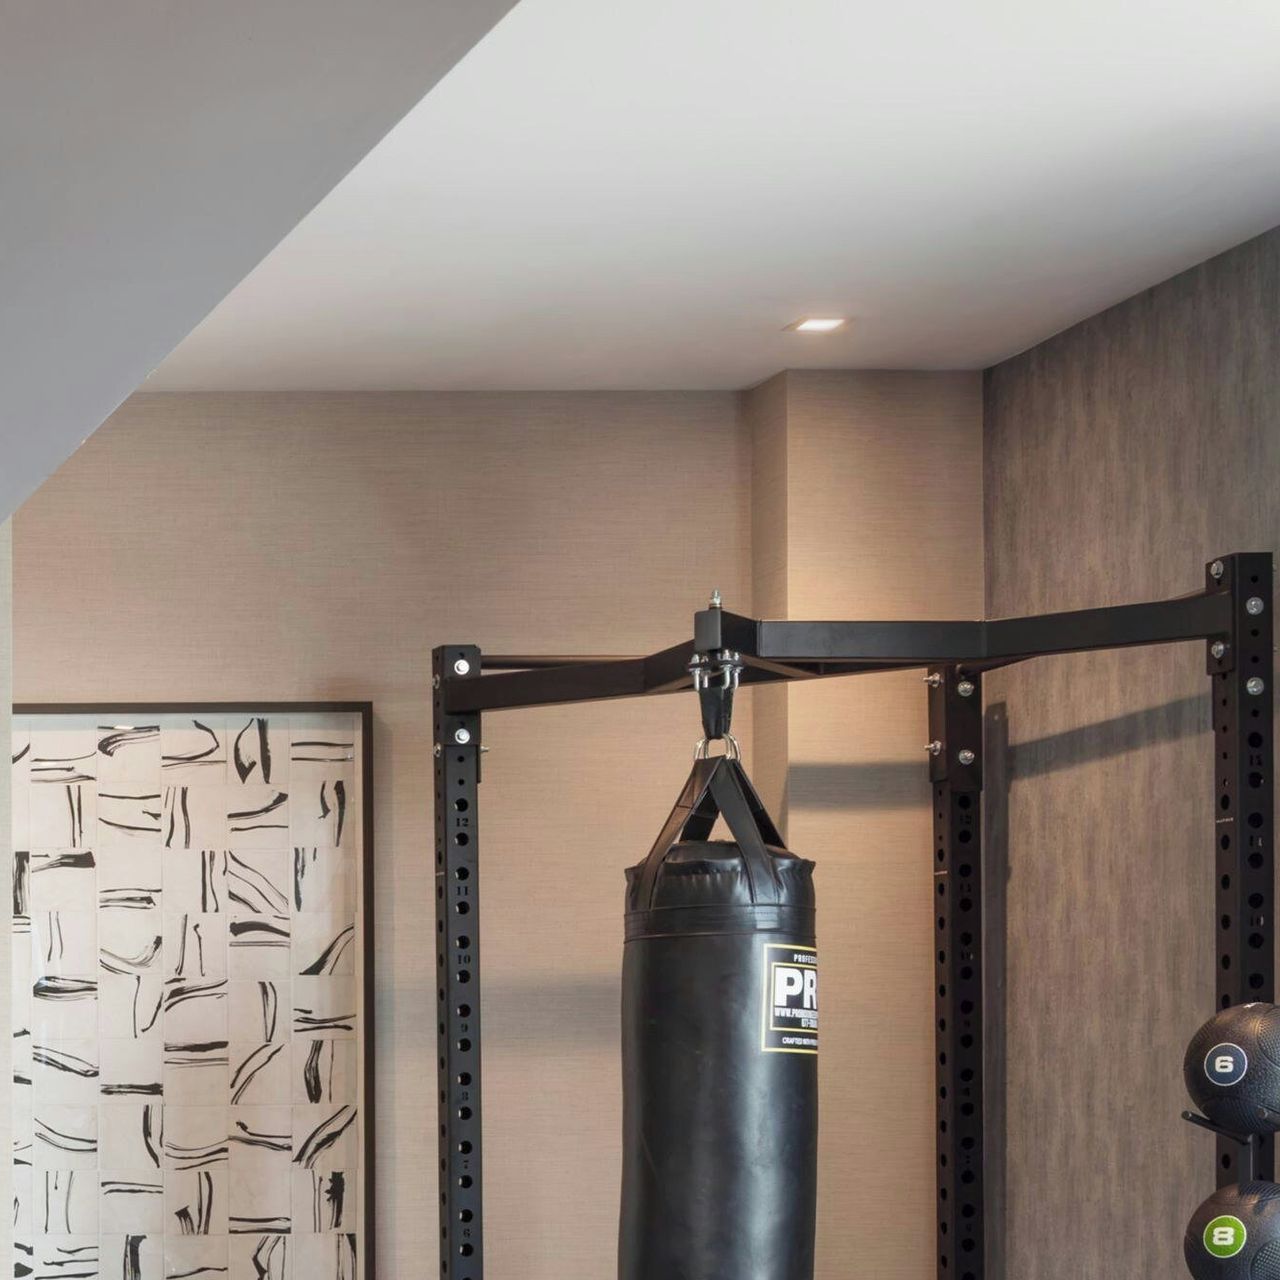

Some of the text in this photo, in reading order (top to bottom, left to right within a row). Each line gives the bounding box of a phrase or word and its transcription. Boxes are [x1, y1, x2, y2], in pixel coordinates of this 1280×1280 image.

[456, 817, 469, 828] 12
[457, 886, 469, 896] 11
[458, 954, 471, 965] 10
[774, 966, 817, 1010] PR
[1214, 1056, 1234, 1073] 6
[1212, 1226, 1235, 1246] 8
